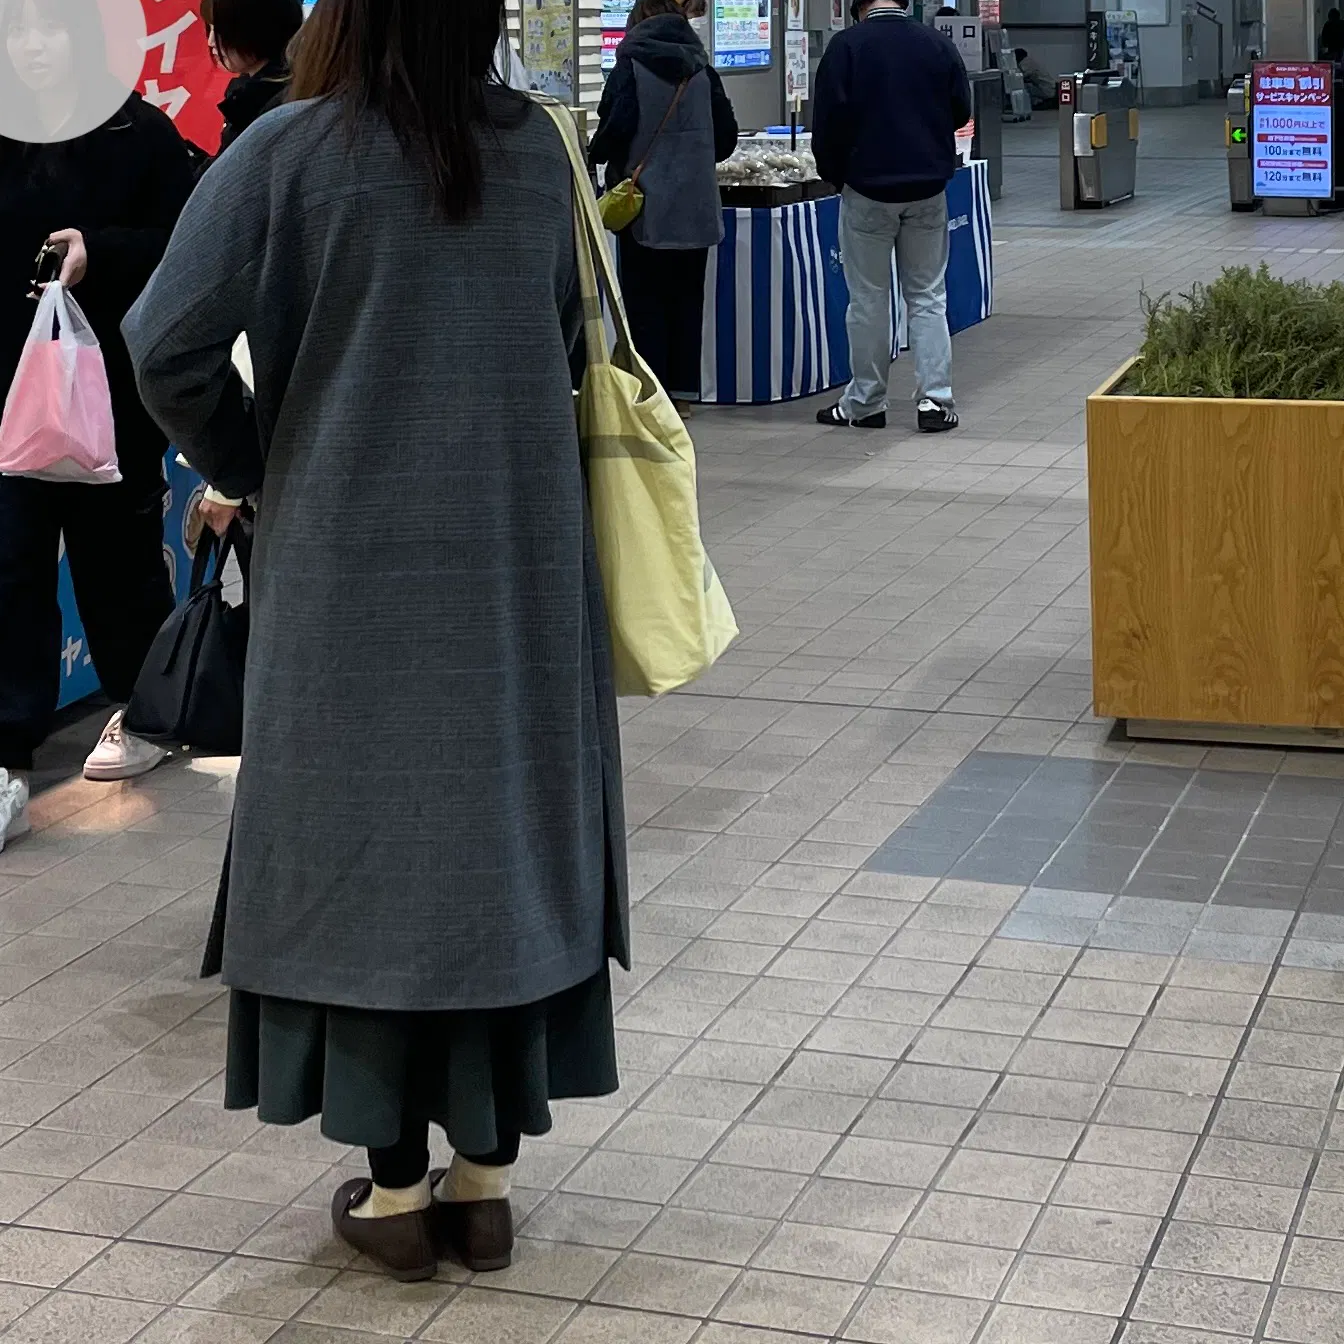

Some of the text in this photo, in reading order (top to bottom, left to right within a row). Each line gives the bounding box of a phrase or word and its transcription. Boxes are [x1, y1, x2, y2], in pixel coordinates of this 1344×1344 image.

[1256, 92, 1330, 103] サービスキャンペーン
[1264, 170, 1322, 182] 120分まで無料
